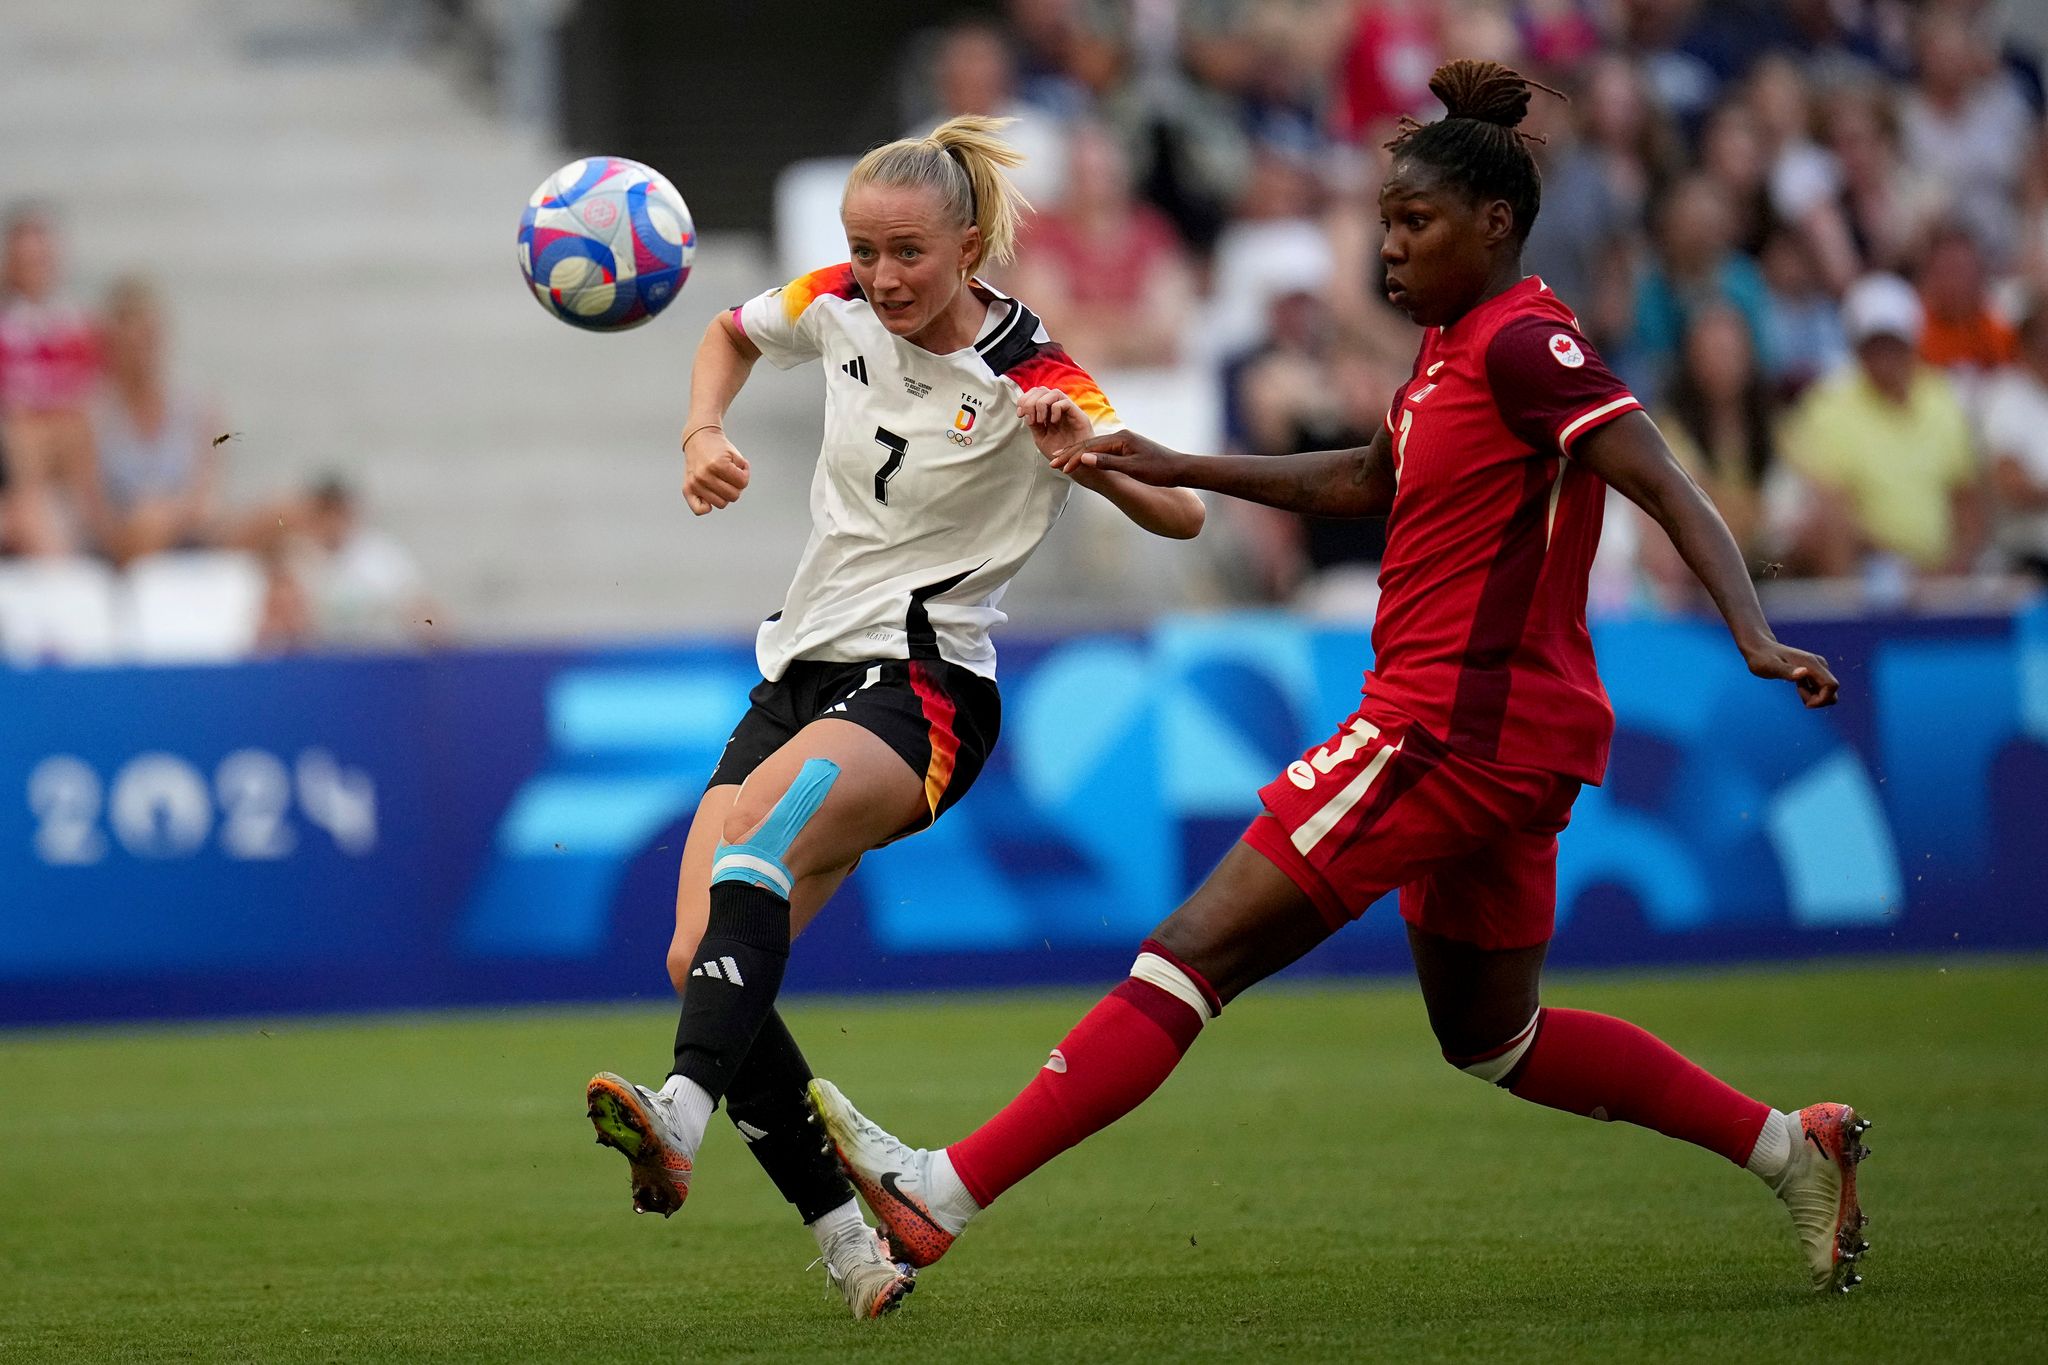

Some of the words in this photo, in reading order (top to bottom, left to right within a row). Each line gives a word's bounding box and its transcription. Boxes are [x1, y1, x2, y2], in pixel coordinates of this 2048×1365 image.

[961, 392, 983, 407] TEAM
[875, 425, 909, 506] 7
[26, 749, 377, 865] 2024
